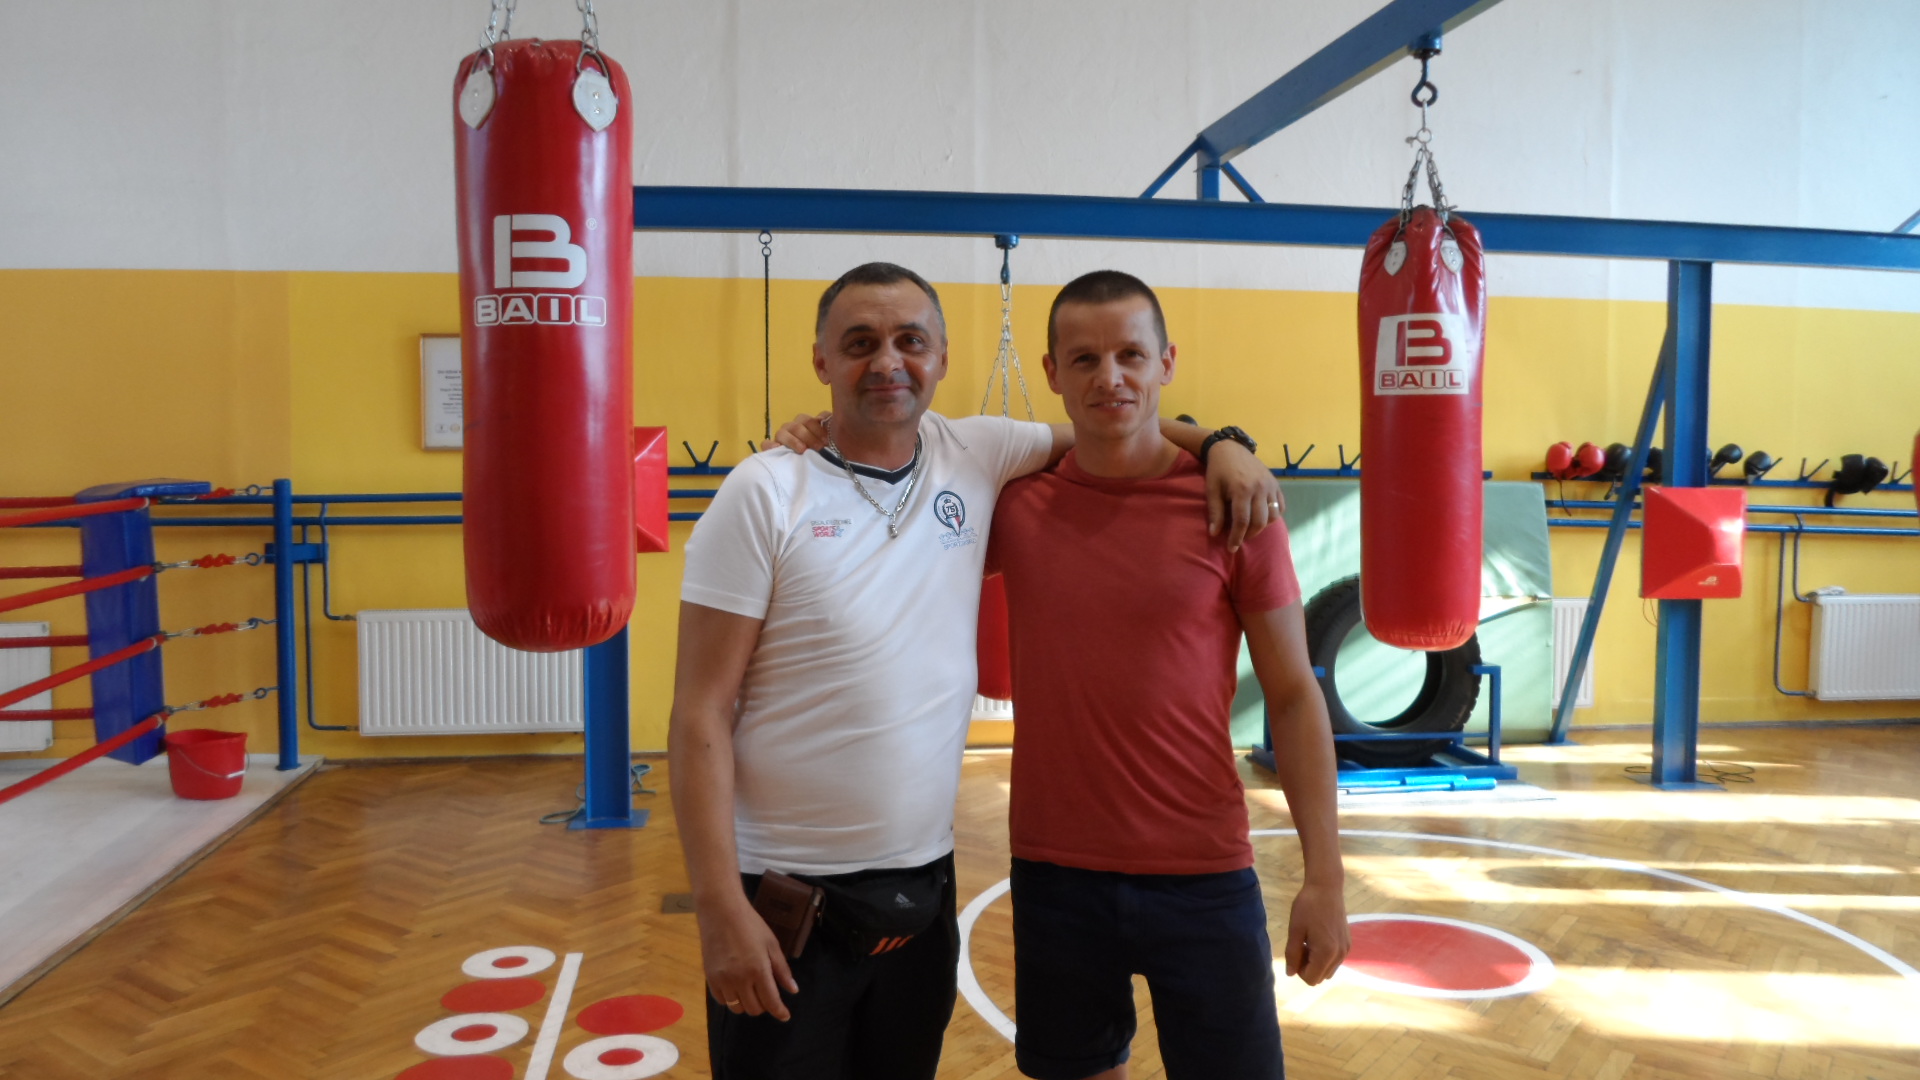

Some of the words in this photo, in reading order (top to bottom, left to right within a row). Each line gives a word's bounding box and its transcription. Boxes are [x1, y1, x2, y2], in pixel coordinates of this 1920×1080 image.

[493, 214, 587, 288] B
[476, 297, 602, 324] BAIL
[1395, 319, 1452, 367] B
[1380, 372, 1462, 388] BAIL
[945, 506, 957, 514] 75
